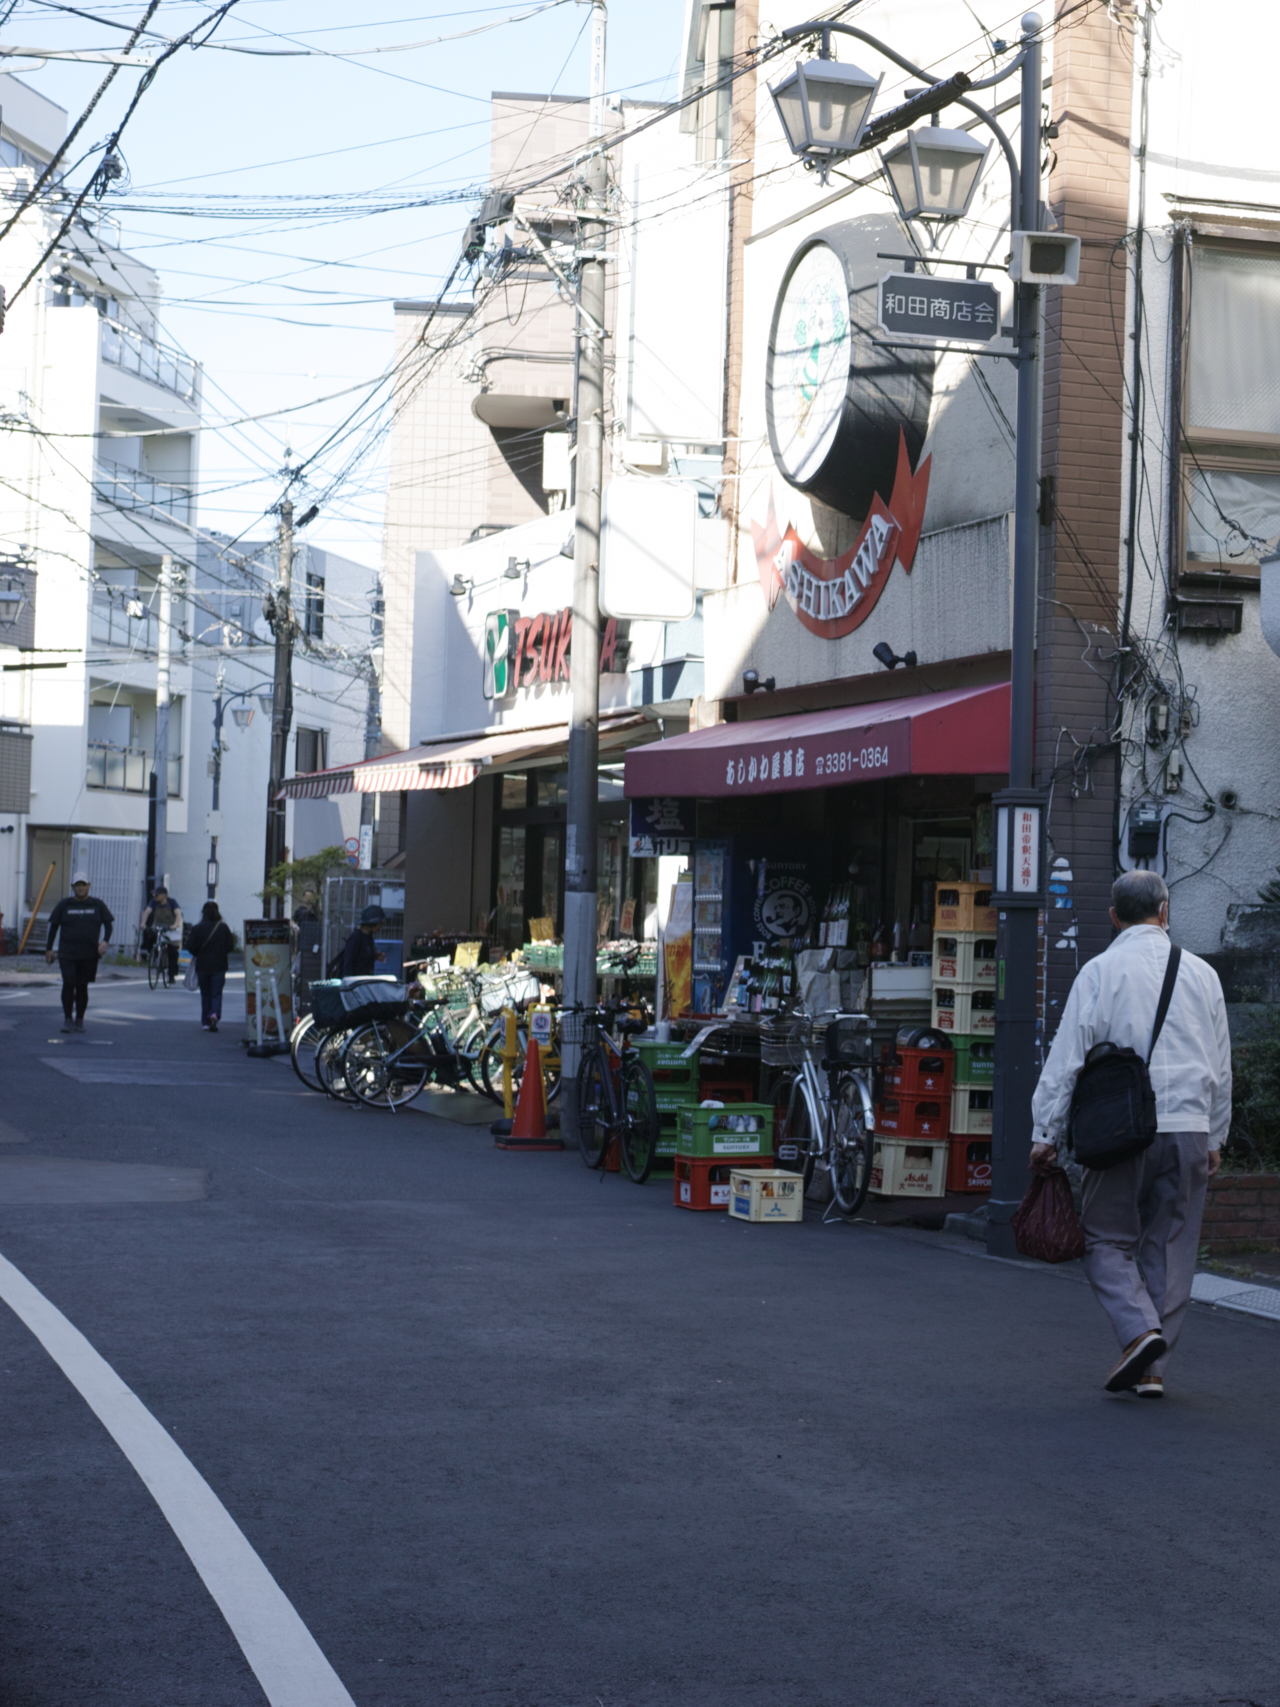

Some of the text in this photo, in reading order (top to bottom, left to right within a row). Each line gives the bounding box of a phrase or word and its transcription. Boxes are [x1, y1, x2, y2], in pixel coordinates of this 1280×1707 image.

[885, 293, 995, 324] 和田商店会
[773, 514, 894, 620] ASHIKAWA
[514, 607, 618, 688] TSUKA
[726, 745, 889, 785] あしかわ屋酒店 3381-0364
[645, 797, 685, 831] 塩
[1021, 811, 1032, 888] 和田帝釈天通り
[904, 1172, 928, 1183] Asahi
[967, 1178, 992, 1187] SAPPOR
